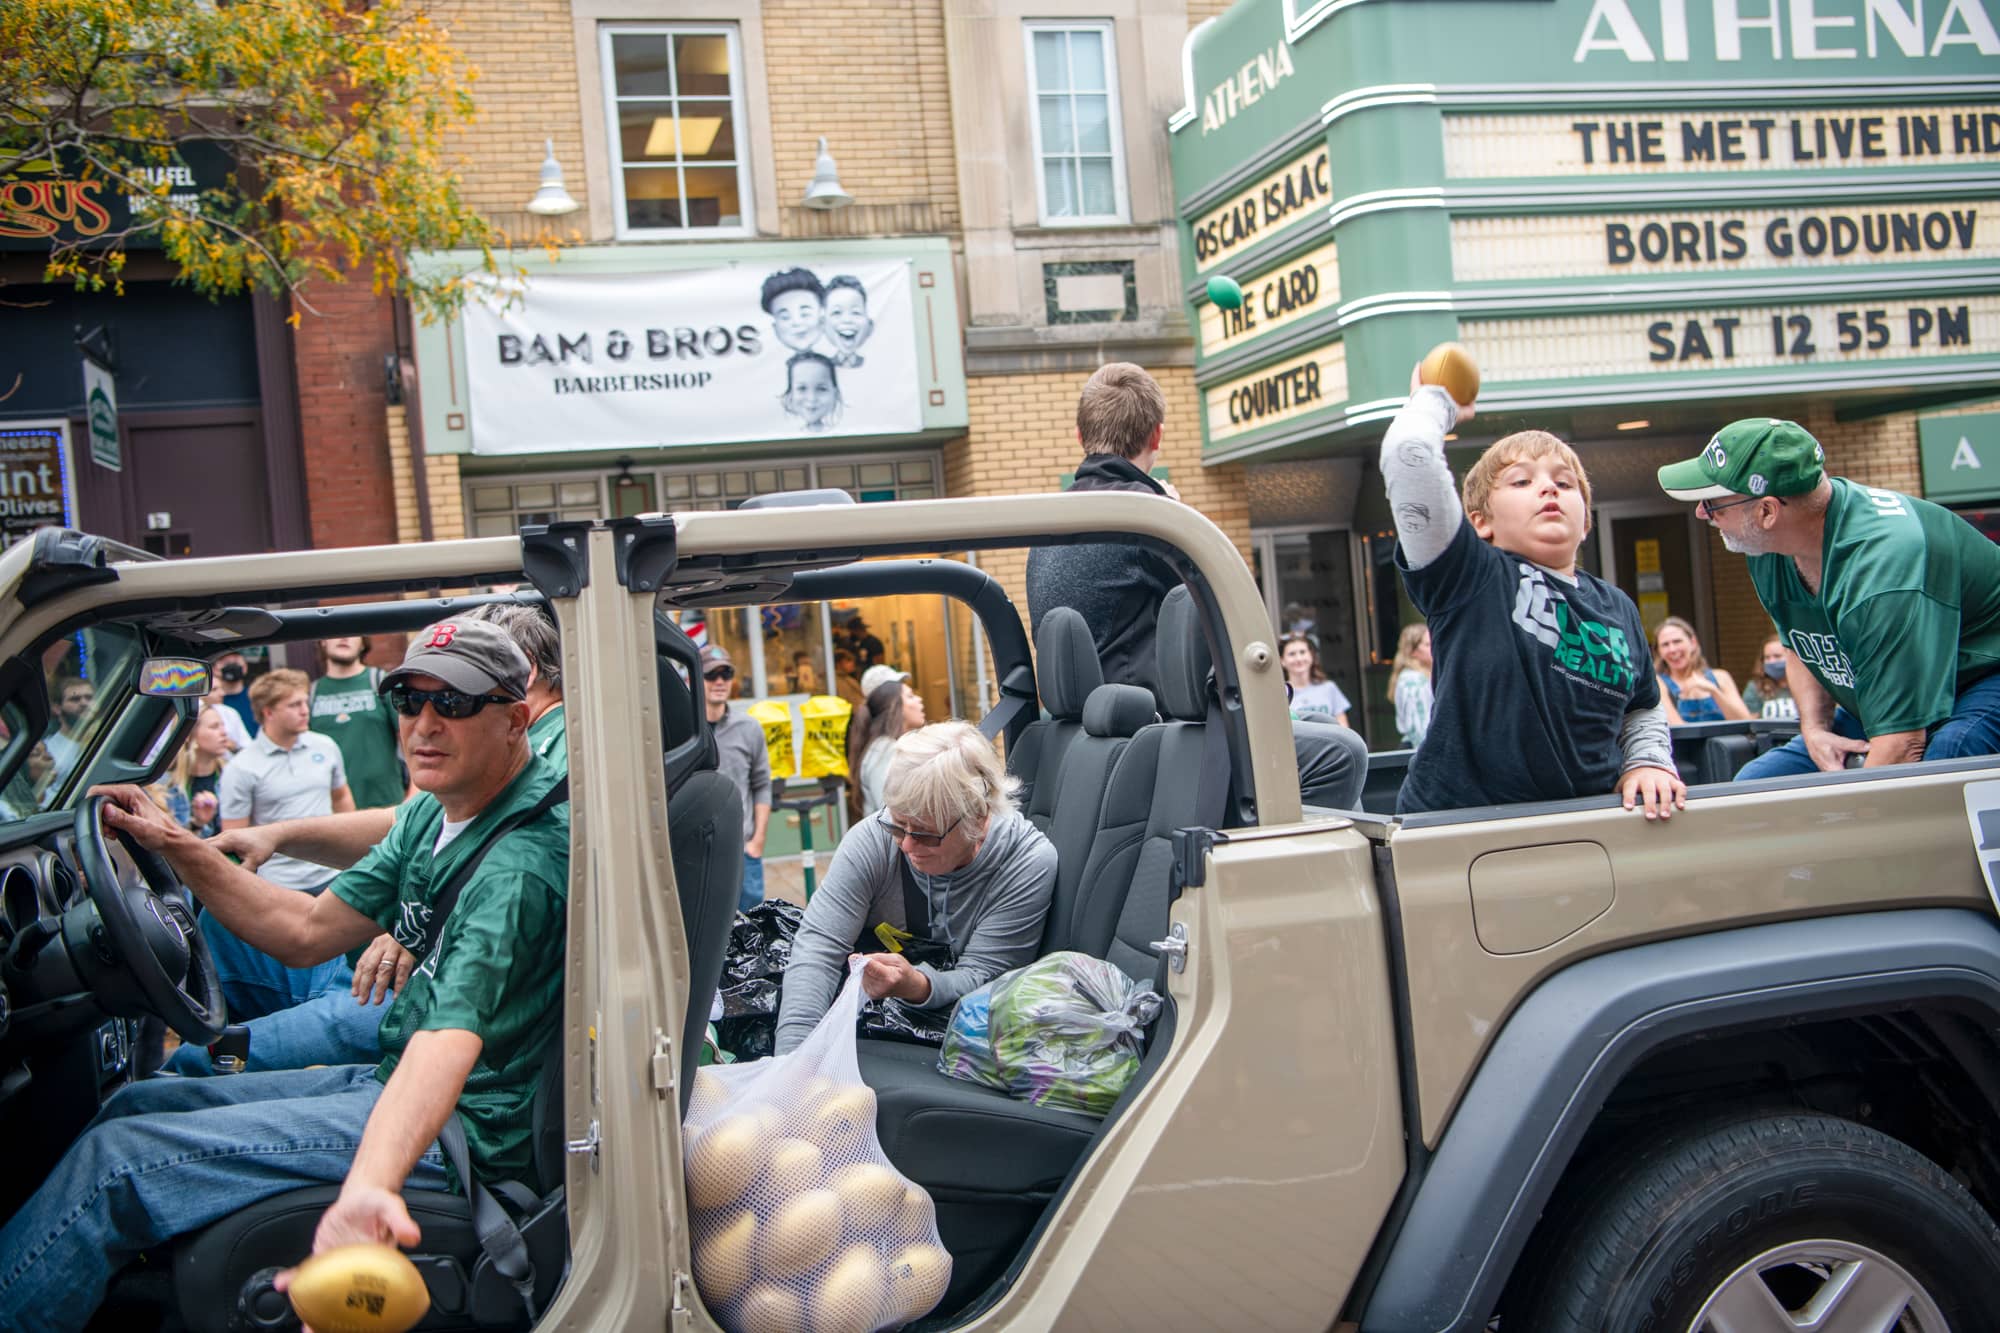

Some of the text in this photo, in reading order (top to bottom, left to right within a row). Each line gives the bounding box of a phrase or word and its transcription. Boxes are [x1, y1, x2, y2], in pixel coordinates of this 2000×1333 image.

[1573, 0, 2000, 62] ATHENA
[1201, 39, 1295, 136] ATHENA
[1572, 112, 2000, 164] THE MET LIVE IN HD
[1195, 155, 1329, 262] OSCAR ISAAC
[1605, 210, 1977, 265] BORIS GODUNOV
[1219, 263, 1320, 340] THE CARD
[497, 324, 763, 367] BAM & BROS
[1648, 305, 1971, 362] SAT 12 55 PM
[553, 371, 712, 396] BARBERSHOP
[1229, 360, 1322, 425] COUNTER
[1951, 436, 1982, 471] A
[424, 623, 457, 648] B
[1556, 601, 1633, 670] LCR
[1554, 640, 1634, 692] REALTY
